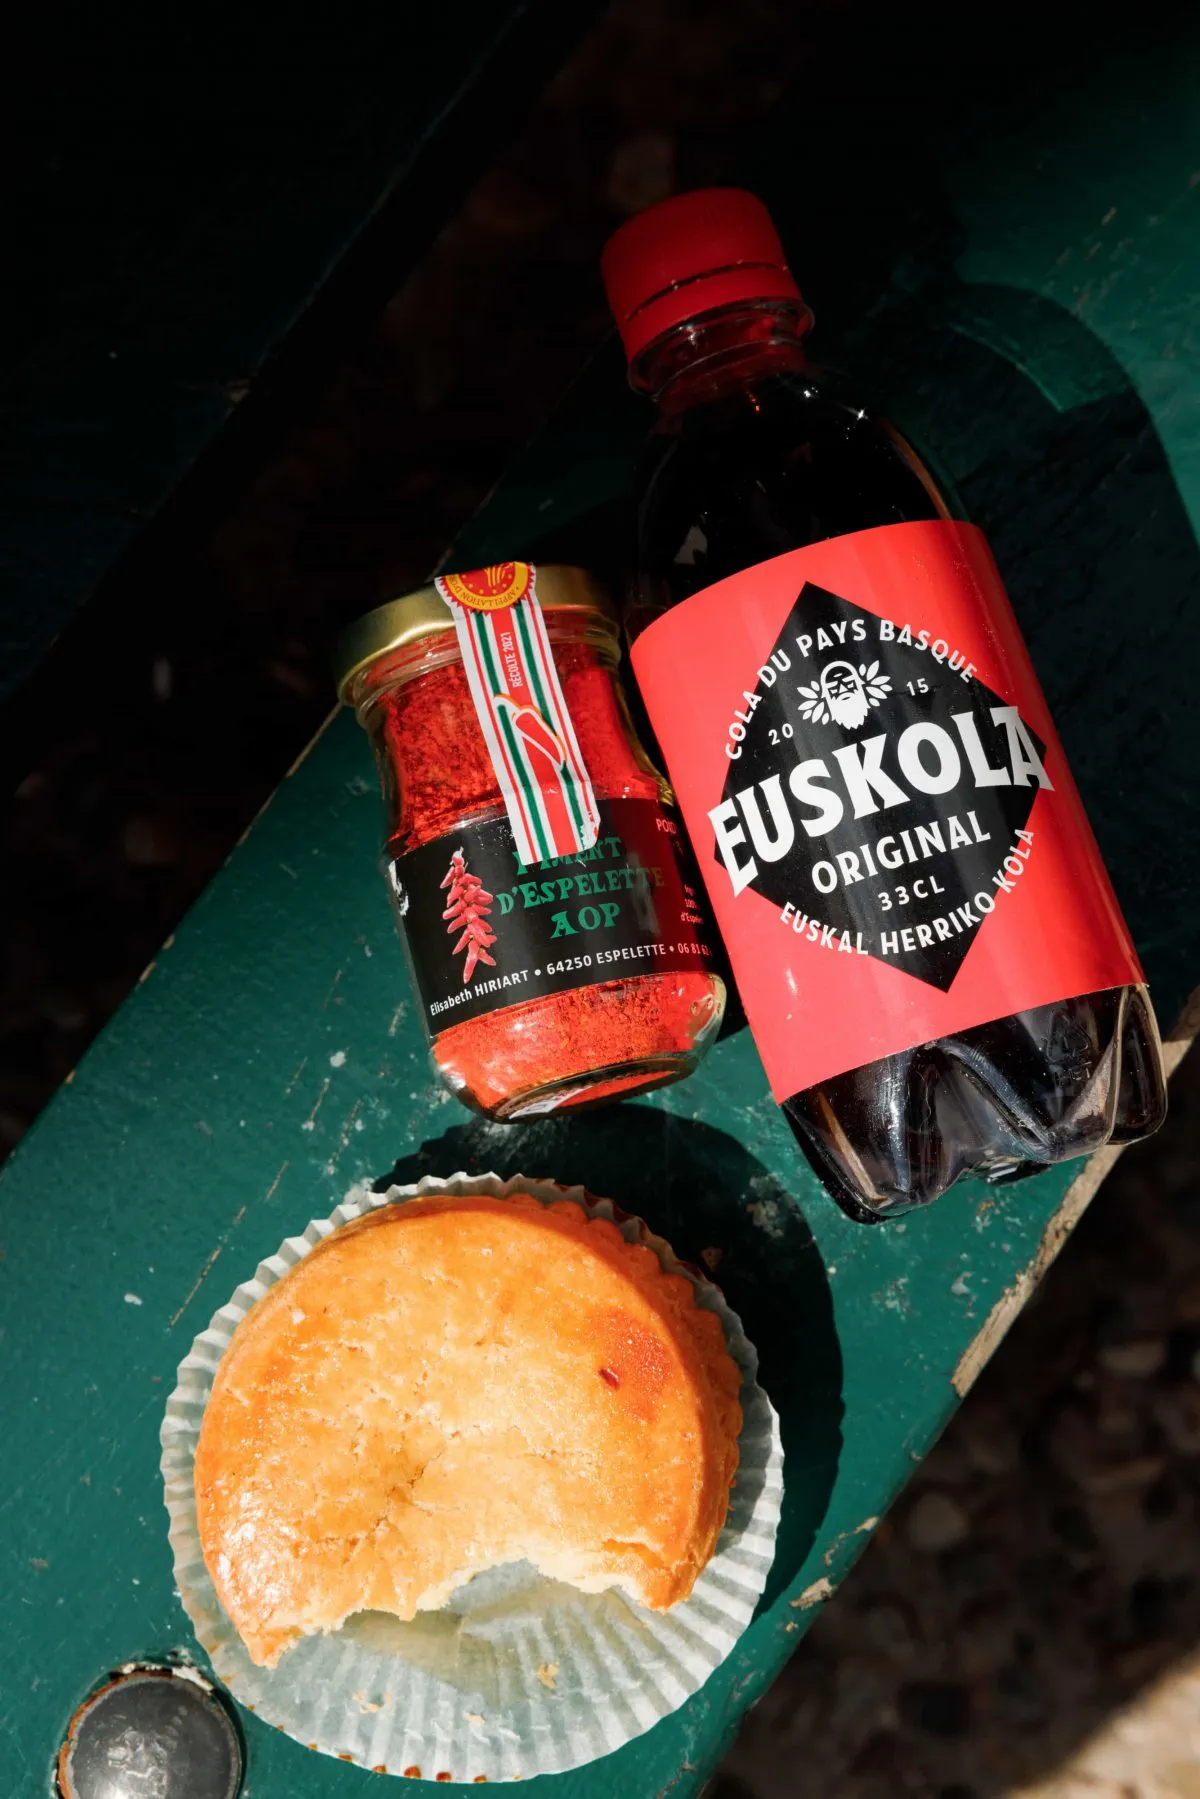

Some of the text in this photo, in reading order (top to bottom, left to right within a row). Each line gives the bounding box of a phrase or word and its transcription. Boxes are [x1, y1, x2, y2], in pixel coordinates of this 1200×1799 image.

[460, 589, 517, 607] APPELLATION
[500, 631, 523, 688] RÉCOLTE 2021
[725, 618, 978, 759] COLA DU PAYS BASQUE
[768, 678, 930, 745] 20 15
[706, 705, 1055, 898] EUSKOLA
[811, 810, 991, 894] ORIGINAL
[550, 903, 621, 939] AOP
[779, 828, 1035, 955] EUSKAL HERRIKO KOLA
[878, 880, 945, 911] 33CL
[429, 988, 473, 1017] Elisabeth
[474, 969, 529, 998] HIRIART
[546, 955, 593, 976] 64250
[595, 943, 667, 964] ESPELETTE
[677, 942, 690, 954] 06
[691, 943, 701, 955] 81
